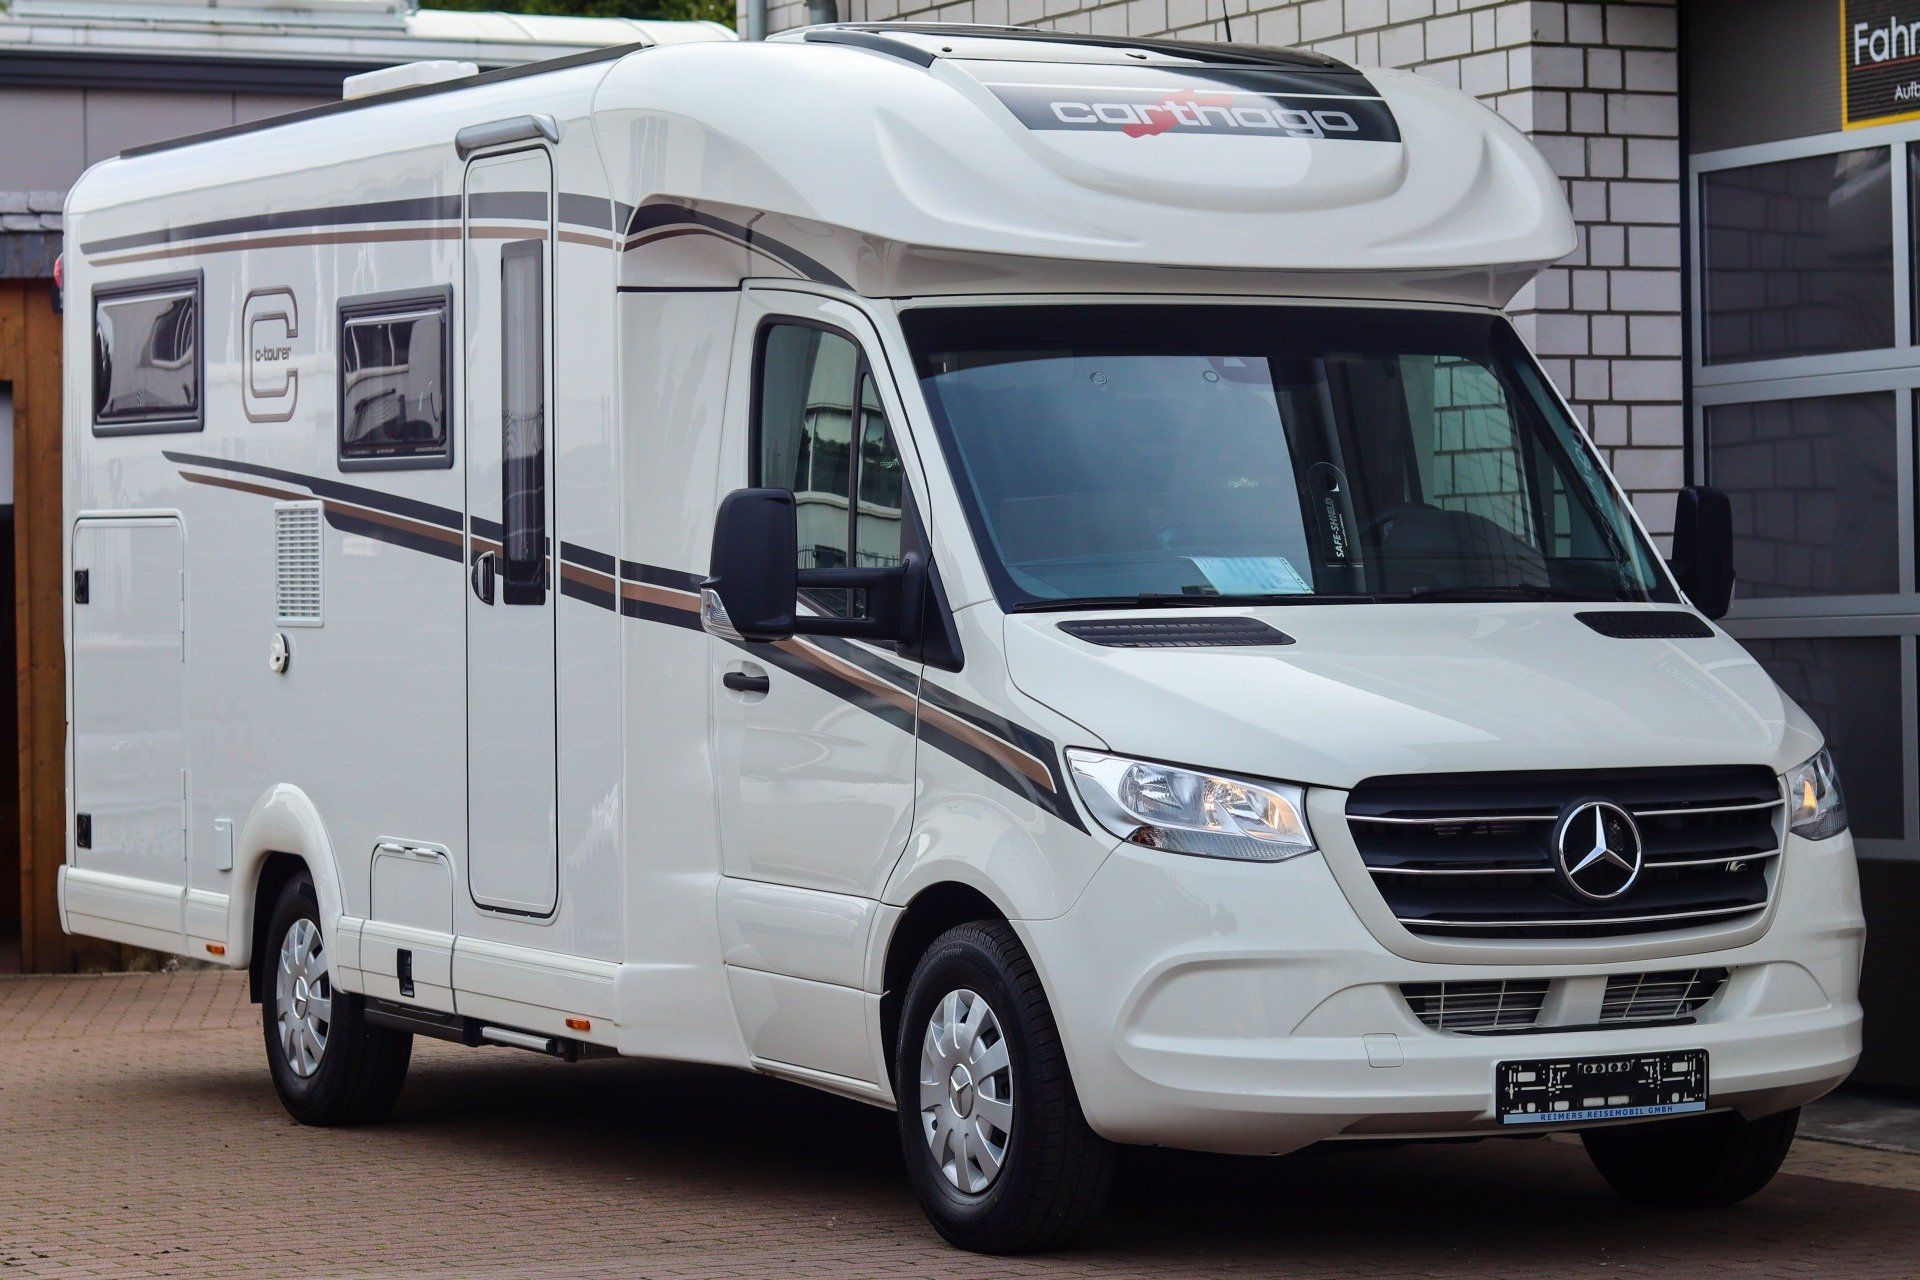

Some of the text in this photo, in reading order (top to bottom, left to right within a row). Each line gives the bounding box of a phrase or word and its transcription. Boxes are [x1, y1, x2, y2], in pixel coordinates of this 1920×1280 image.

[1050, 100, 1359, 139] carthago
[255, 346, 292, 362] c-tourer
[1325, 497, 1345, 558] SAFE-SHIELD
[1540, 1105, 1674, 1121] REIMERS REISEMOBIL GMBH
